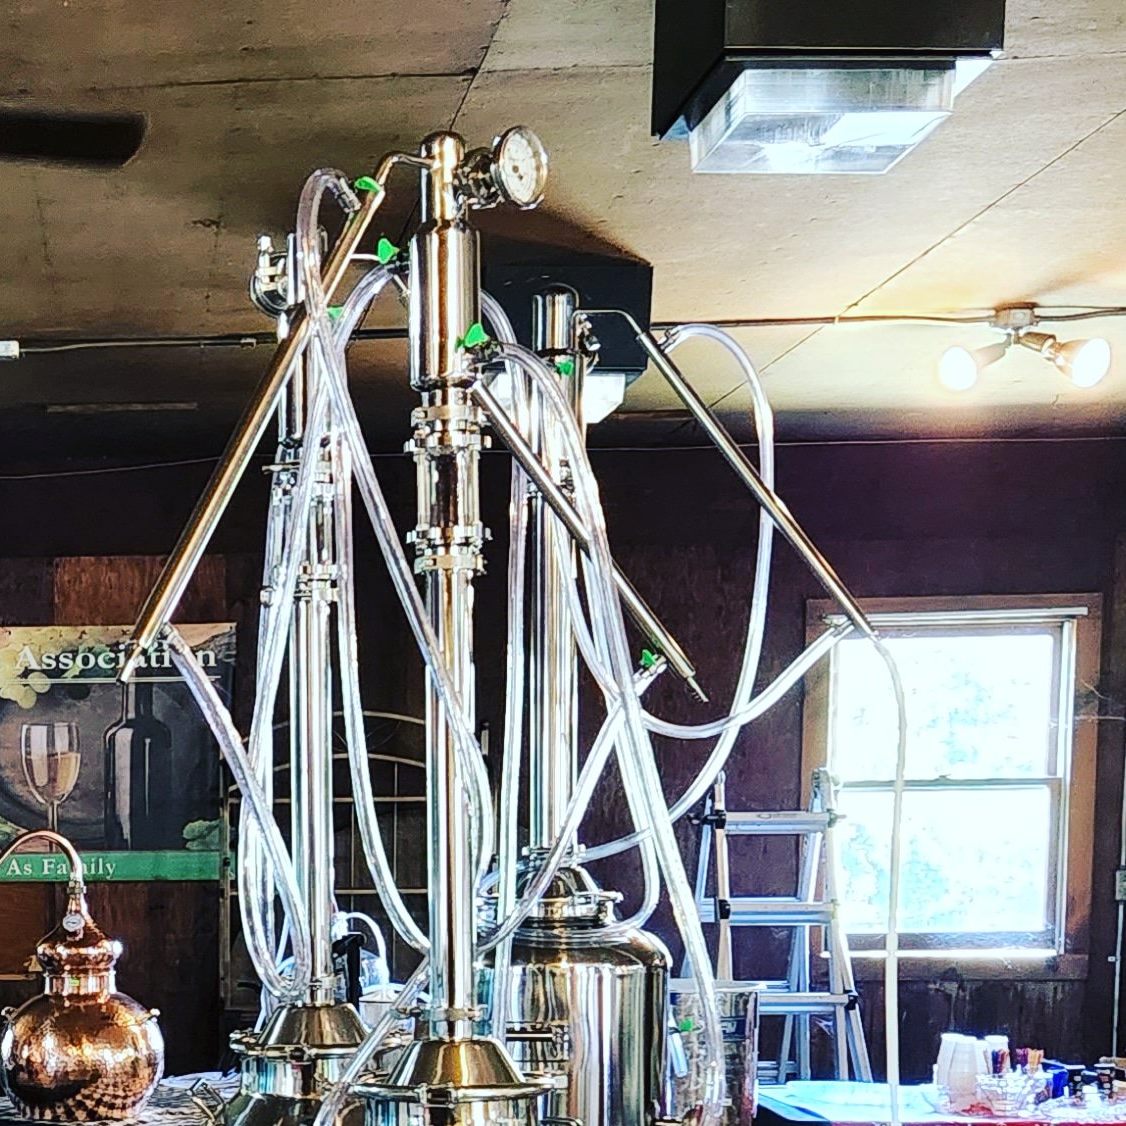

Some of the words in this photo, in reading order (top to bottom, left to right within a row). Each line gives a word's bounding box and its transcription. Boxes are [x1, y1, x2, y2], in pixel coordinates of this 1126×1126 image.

[15, 643, 218, 670] Associatin
[6, 858, 33, 876] As
[42, 858, 116, 880] Faily
